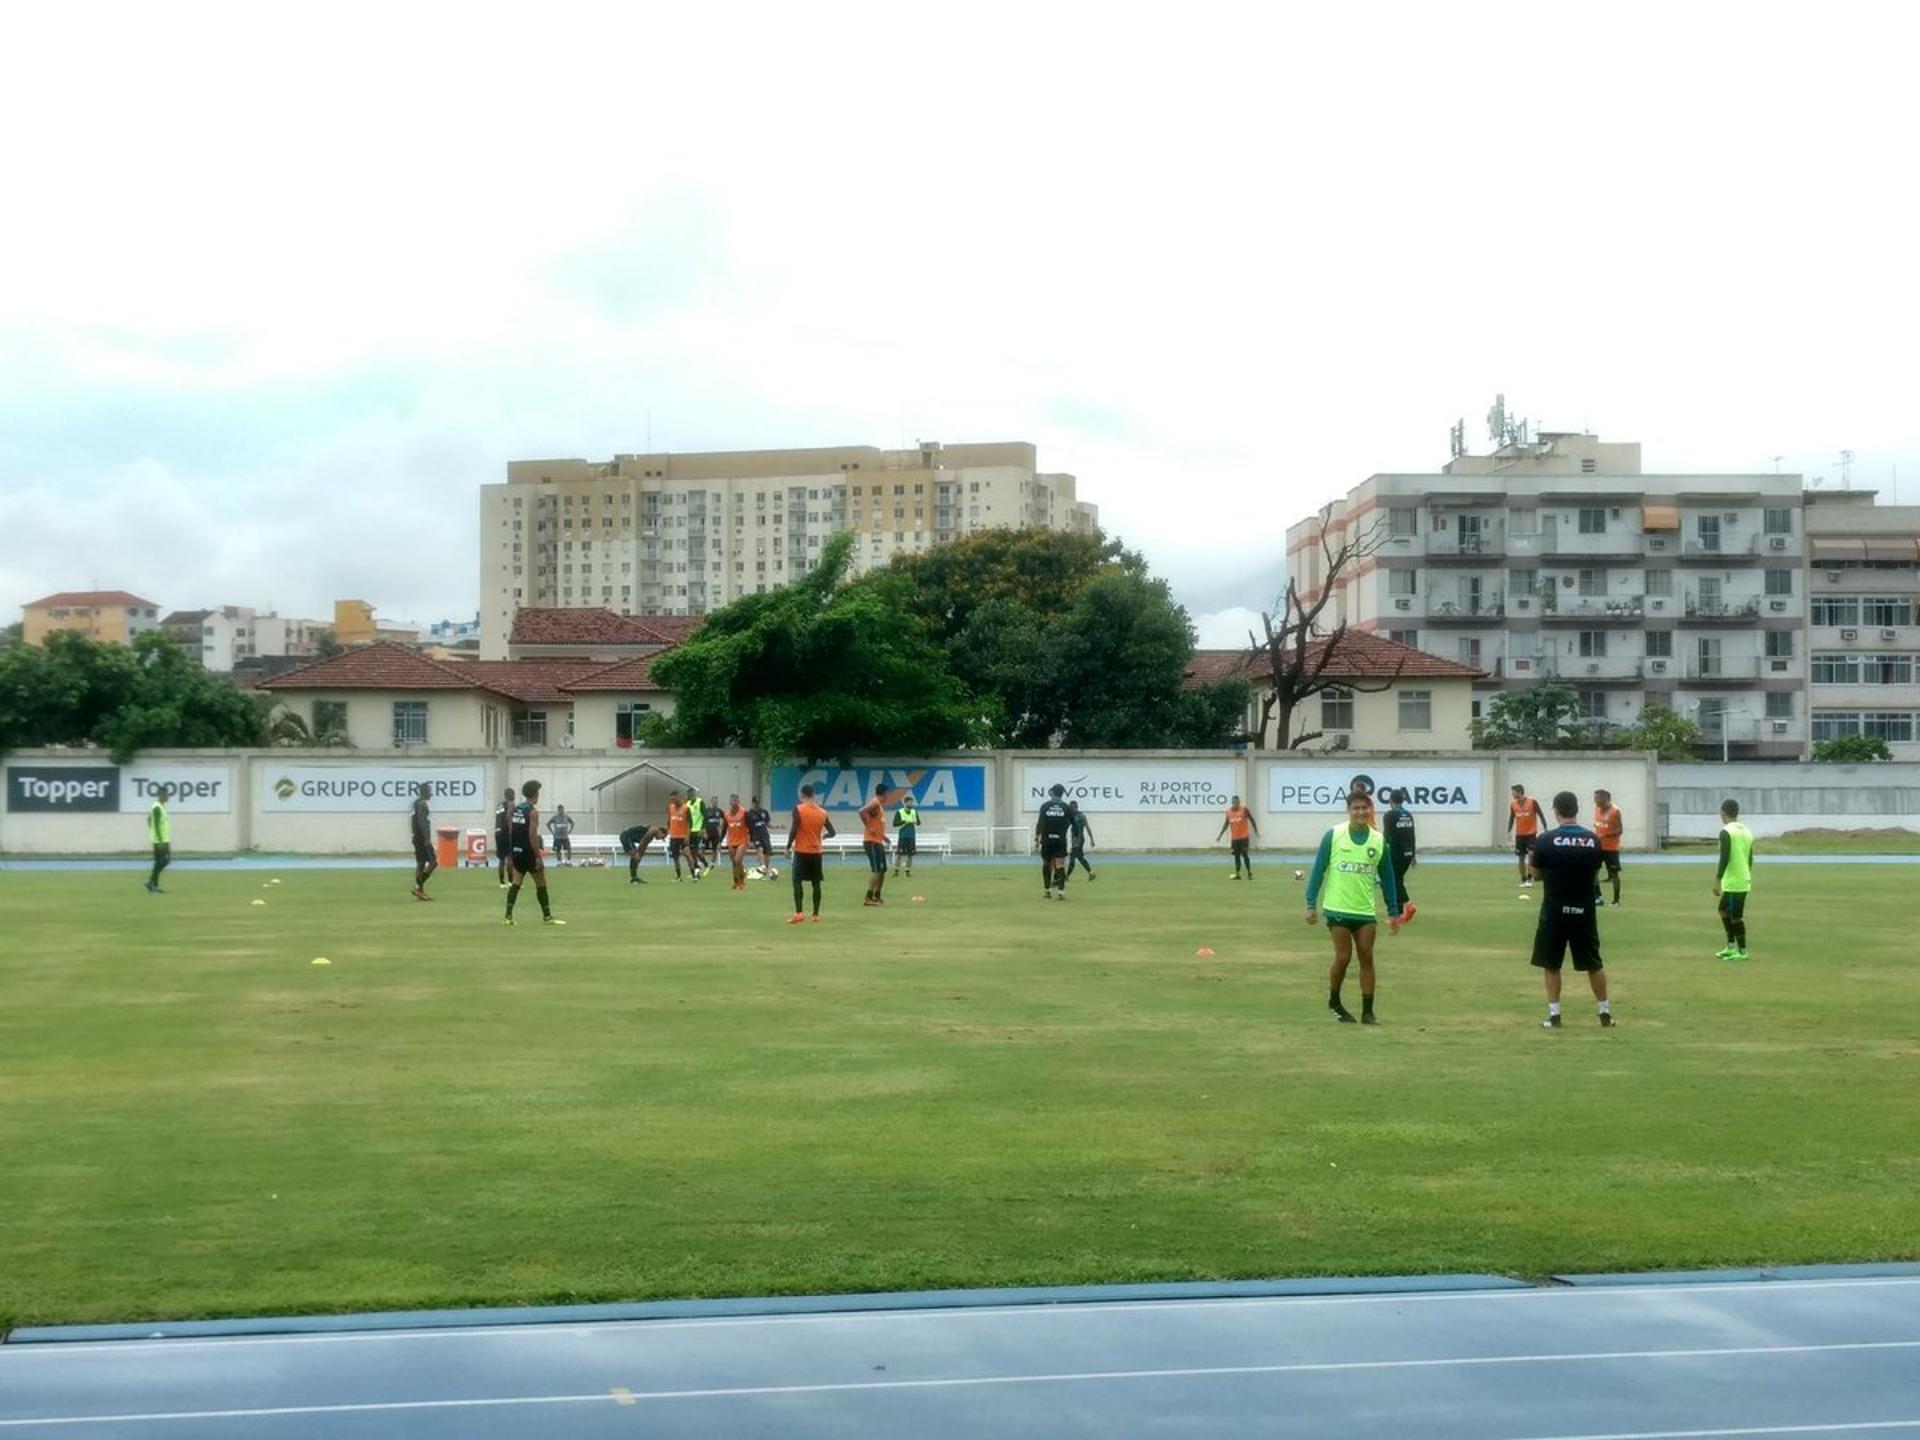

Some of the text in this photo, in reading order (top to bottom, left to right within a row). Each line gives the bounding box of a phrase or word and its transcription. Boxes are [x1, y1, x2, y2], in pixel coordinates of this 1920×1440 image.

[18, 777, 109, 803] Topper
[301, 780, 376, 797] GRUPO
[797, 769, 960, 807] CAIXA
[1140, 781, 1212, 793] RJ PORTO
[1281, 786, 1468, 805] PEGA CARGA
[472, 838, 485, 853] G
[1553, 836, 1595, 848] CAIXA
